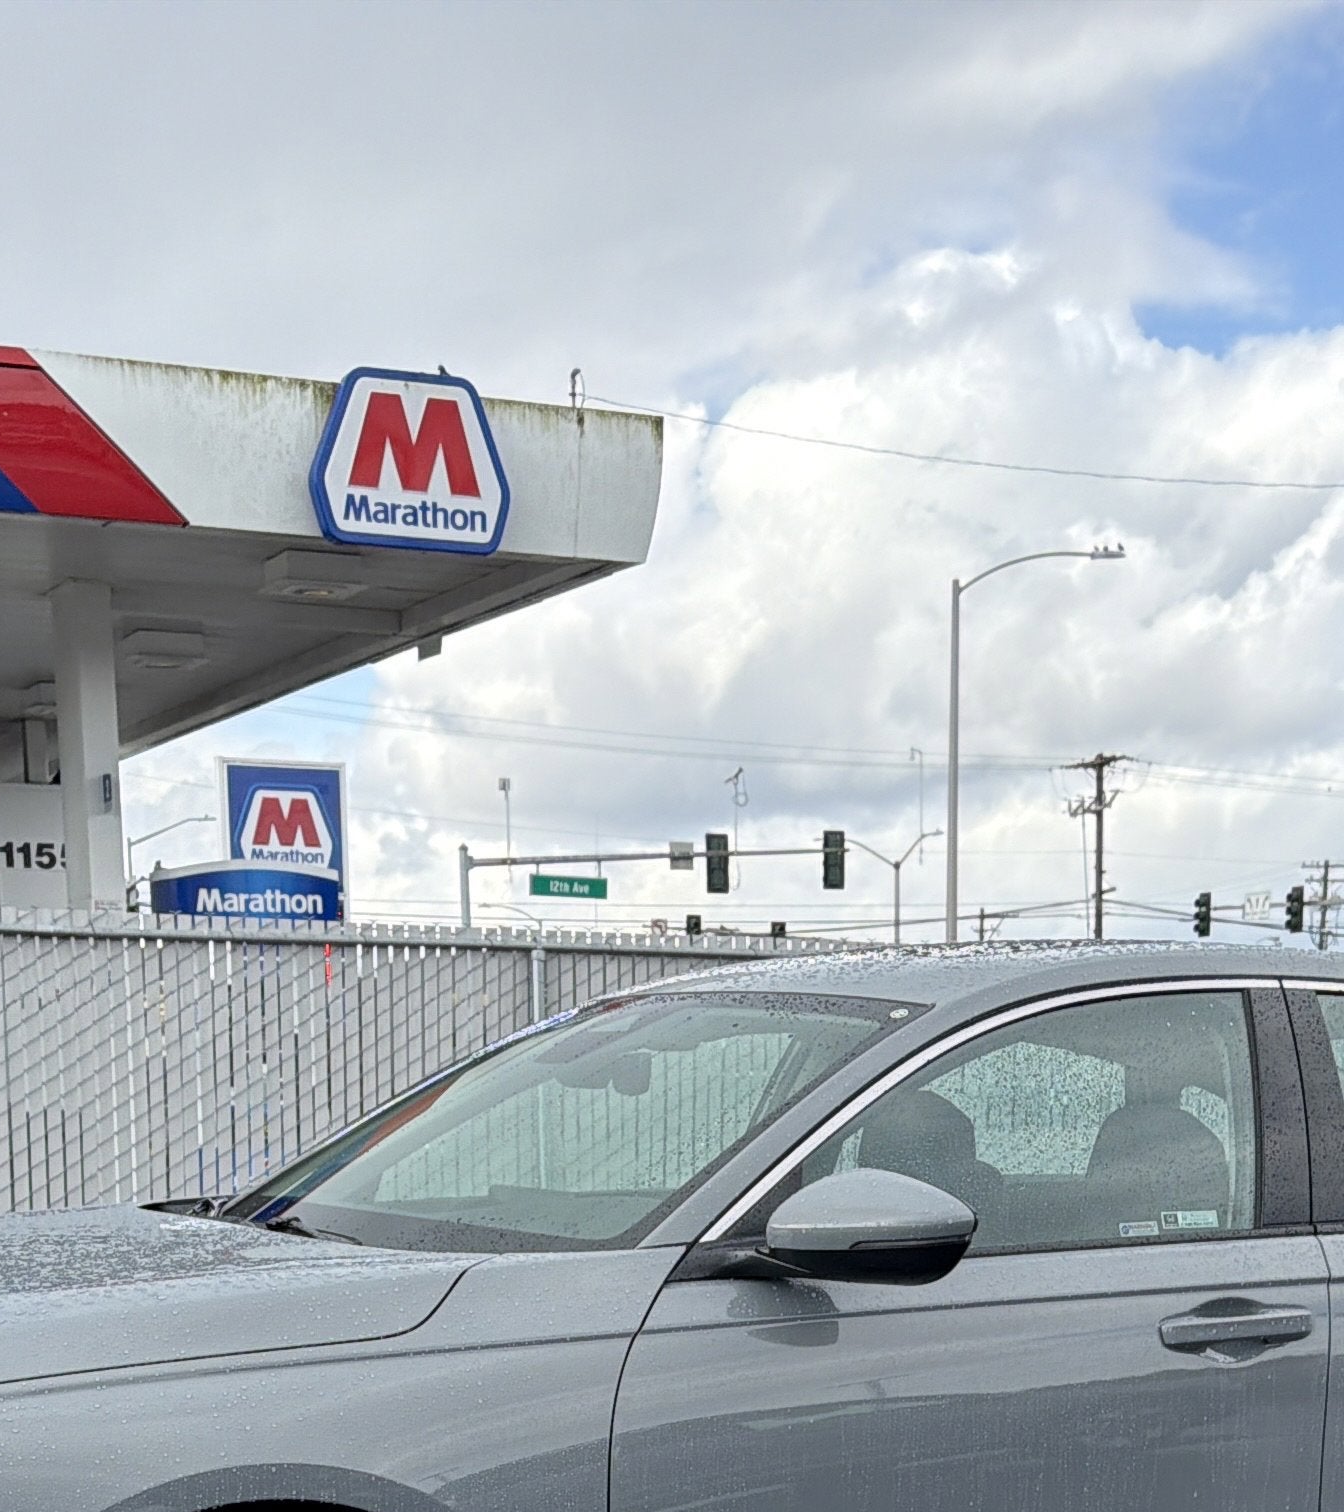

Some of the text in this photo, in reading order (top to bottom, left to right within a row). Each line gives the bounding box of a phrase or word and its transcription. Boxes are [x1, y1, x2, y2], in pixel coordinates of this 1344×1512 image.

[348, 391, 482, 499] M
[343, 493, 488, 533] Marathon
[252, 797, 322, 849] M
[251, 847, 325, 865] Marathon
[196, 886, 324, 915] Marathon
[549, 879, 590, 895] 12th Ave
